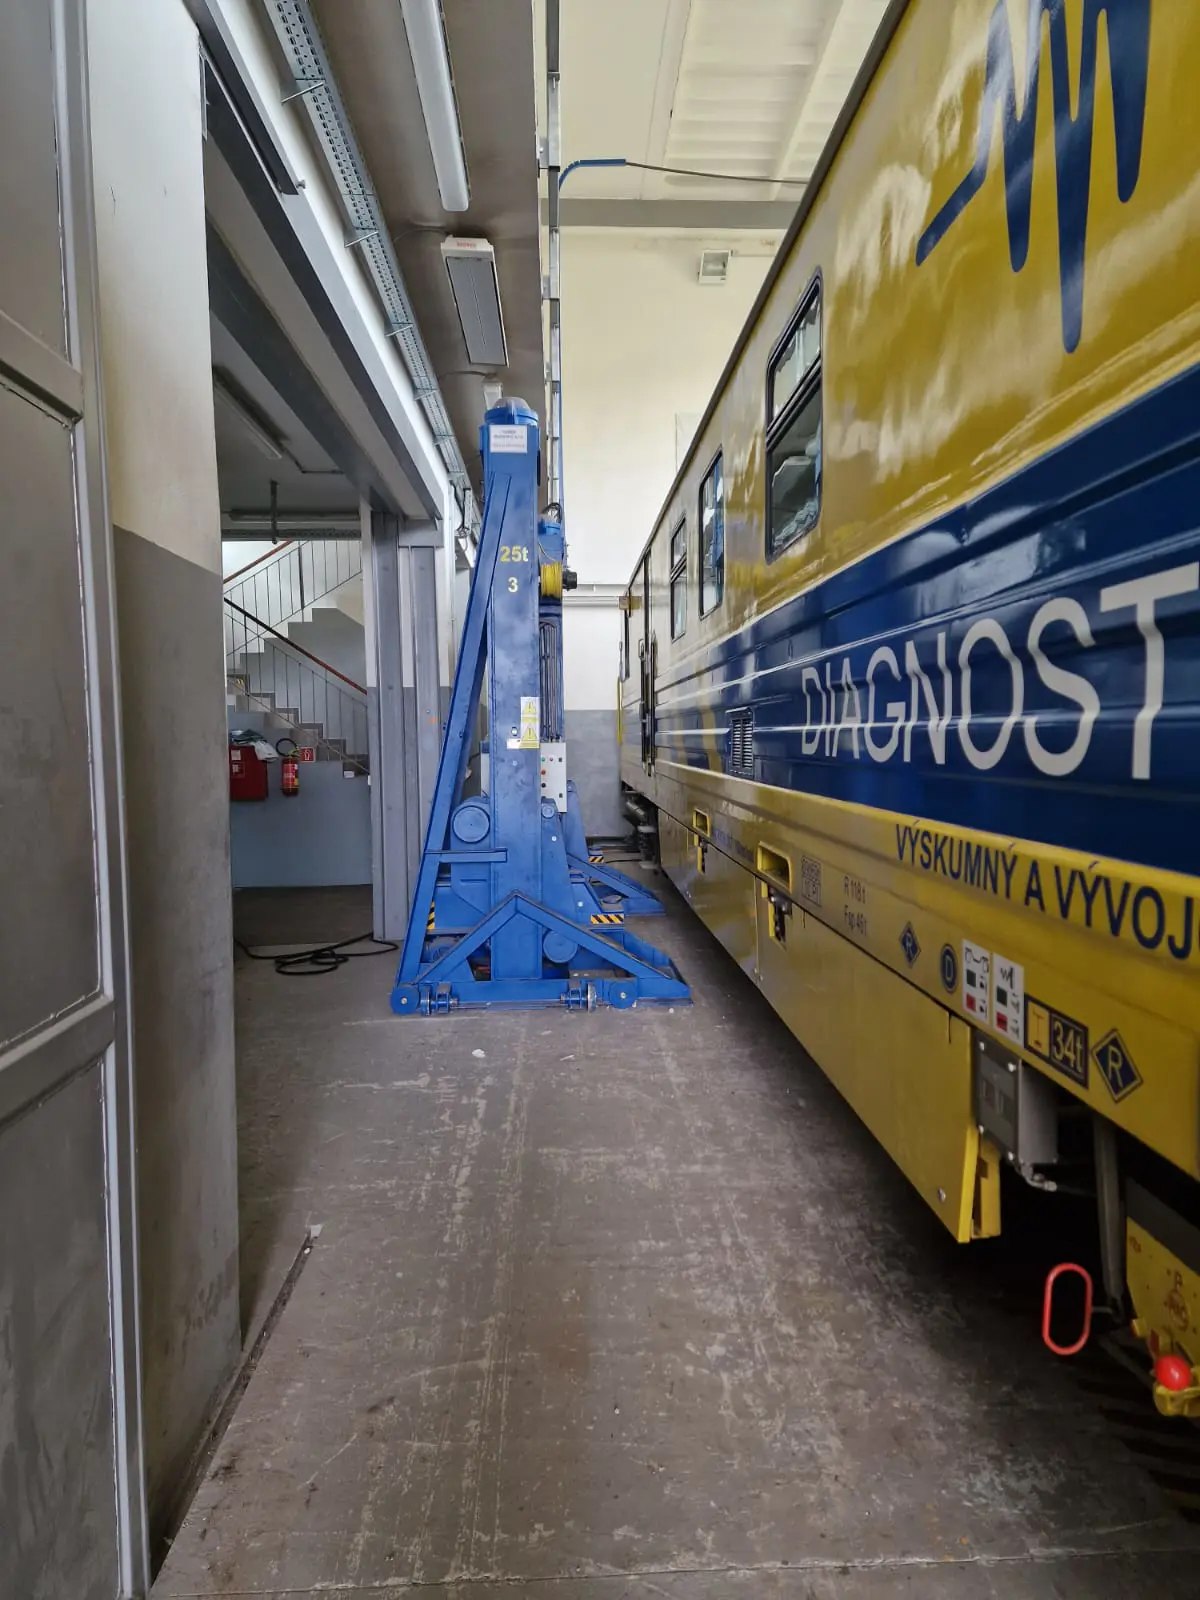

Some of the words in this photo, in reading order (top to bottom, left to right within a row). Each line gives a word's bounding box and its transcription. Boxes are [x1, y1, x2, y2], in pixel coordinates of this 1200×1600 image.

[500, 546, 529, 562] 25t
[508, 576, 518, 593] 3
[802, 562, 1199, 779] DIAGNOST
[896, 820, 1018, 899] VÝSKUMNÝ
[1024, 860, 1045, 912] A
[1054, 861, 1200, 960] VÝVOJ
[905, 931, 914, 955] R
[945, 955, 954, 981] D
[1054, 1020, 1082, 1075] 34t
[1108, 1044, 1123, 1088] R
